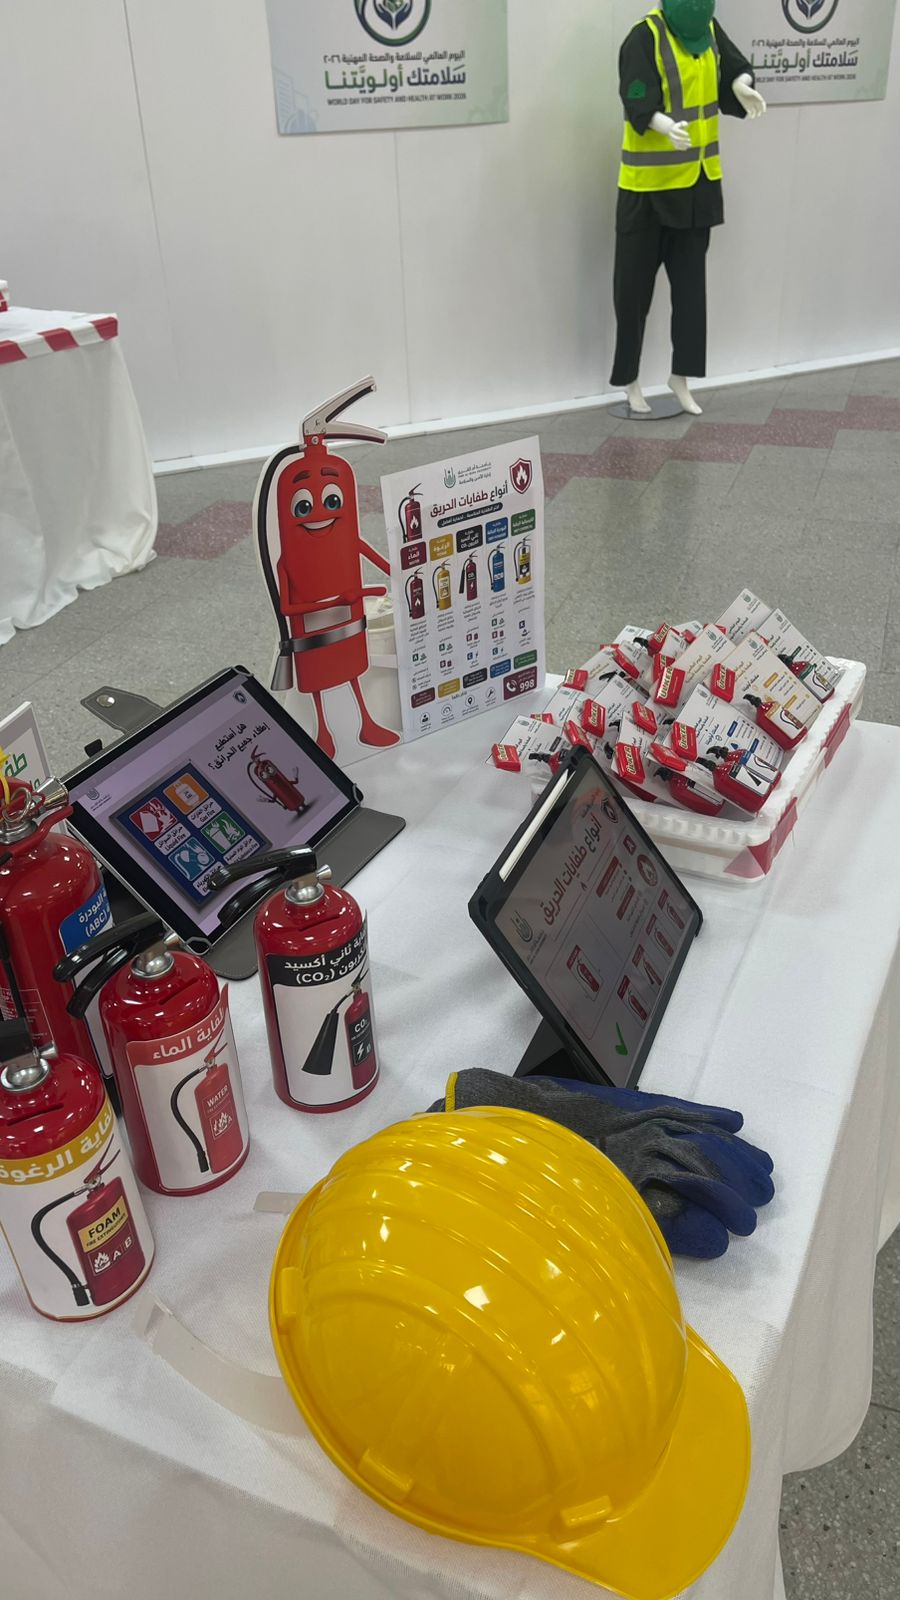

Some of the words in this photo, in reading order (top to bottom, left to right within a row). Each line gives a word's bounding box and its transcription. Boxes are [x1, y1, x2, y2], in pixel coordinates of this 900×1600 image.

[342, 53, 367, 65] المهنية
[369, 52, 394, 64] والصحة
[396, 52, 422, 61] للسلامة
[423, 51, 448, 64] العالمي
[448, 50, 464, 62] اليوم
[328, 98, 346, 106] WORLD
[374, 96, 394, 104] SAFETY
[458, 490, 488, 508] طفايات
[490, 480, 508, 502] أنواع
[430, 498, 456, 518] الحريق
[520, 679, 535, 692] 998
[236, 724, 247, 734] هل
[215, 728, 237, 752] أستطيع
[237, 738, 252, 752] جميع
[562, 844, 587, 886] طفايات
[78, 892, 104, 923] البودرة
[540, 878, 567, 926] الحريق
[86, 909, 107, 937] (ABC)
[284, 954, 326, 971] أكسيد
[330, 943, 352, 967] ثاني
[153, 1036, 192, 1059] الماء
[0, 1149, 74, 1182] الرغوة
[88, 1207, 121, 1238] FOAM
[113, 1250, 121, 1261] A
[124, 1236, 132, 1249] B
